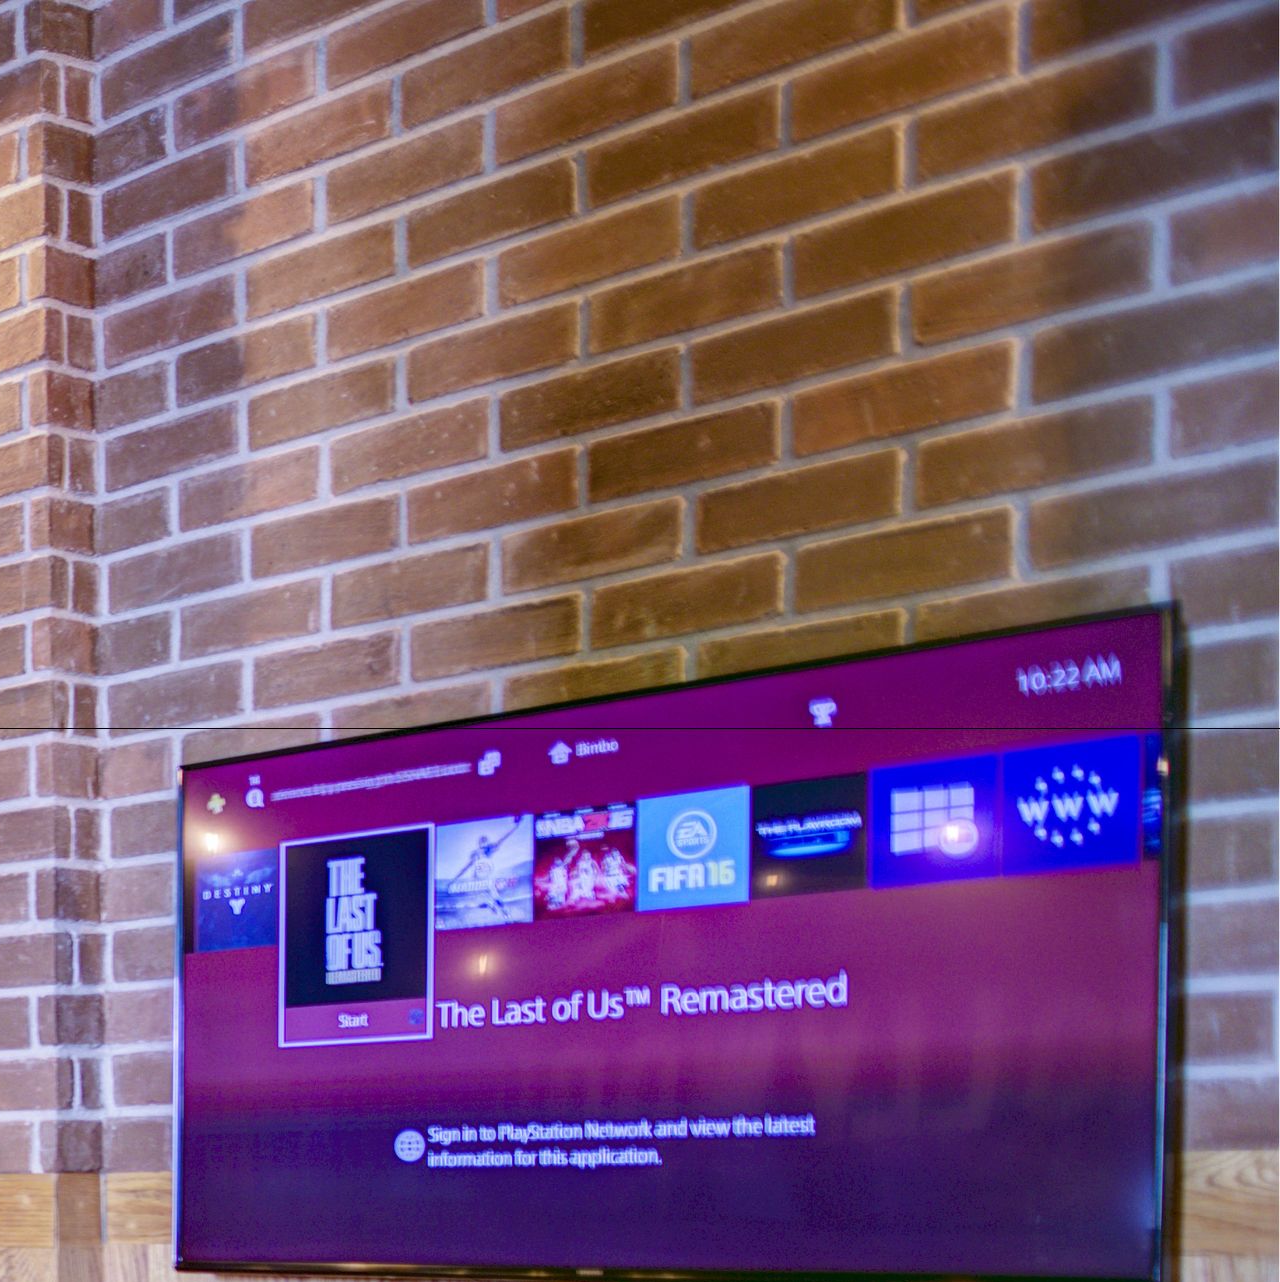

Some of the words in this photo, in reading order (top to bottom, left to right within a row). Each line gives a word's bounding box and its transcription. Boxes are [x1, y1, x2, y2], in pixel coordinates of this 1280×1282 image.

[1017, 660, 1080, 696] 10:22
[1082, 652, 1122, 688] AM
[677, 821, 709, 838] EA
[202, 882, 274, 900] DESTINY
[327, 857, 365, 897] THE
[648, 863, 705, 893] FIFA
[706, 859, 736, 886] 16
[326, 893, 377, 934] LAST
[326, 932, 350, 970] OF
[436, 1000, 486, 1028] The
[491, 997, 546, 1026] Last
[552, 990, 583, 1023] of
[660, 969, 848, 1017] Remastered
[338, 1013, 369, 1028] Start
[428, 1125, 461, 1146] Sign
[462, 1124, 478, 1142] in
[479, 1124, 496, 1142] to
[497, 1121, 583, 1144] PlayStation
[584, 1117, 653, 1139] Network
[653, 1116, 688, 1138] and
[689, 1115, 731, 1138] view
[732, 1113, 763, 1137] the
[764, 1112, 816, 1136] latest
[427, 1148, 513, 1168] information
[514, 1147, 538, 1167] for
[538, 1146, 568, 1167] this
[568, 1144, 663, 1170] application.
